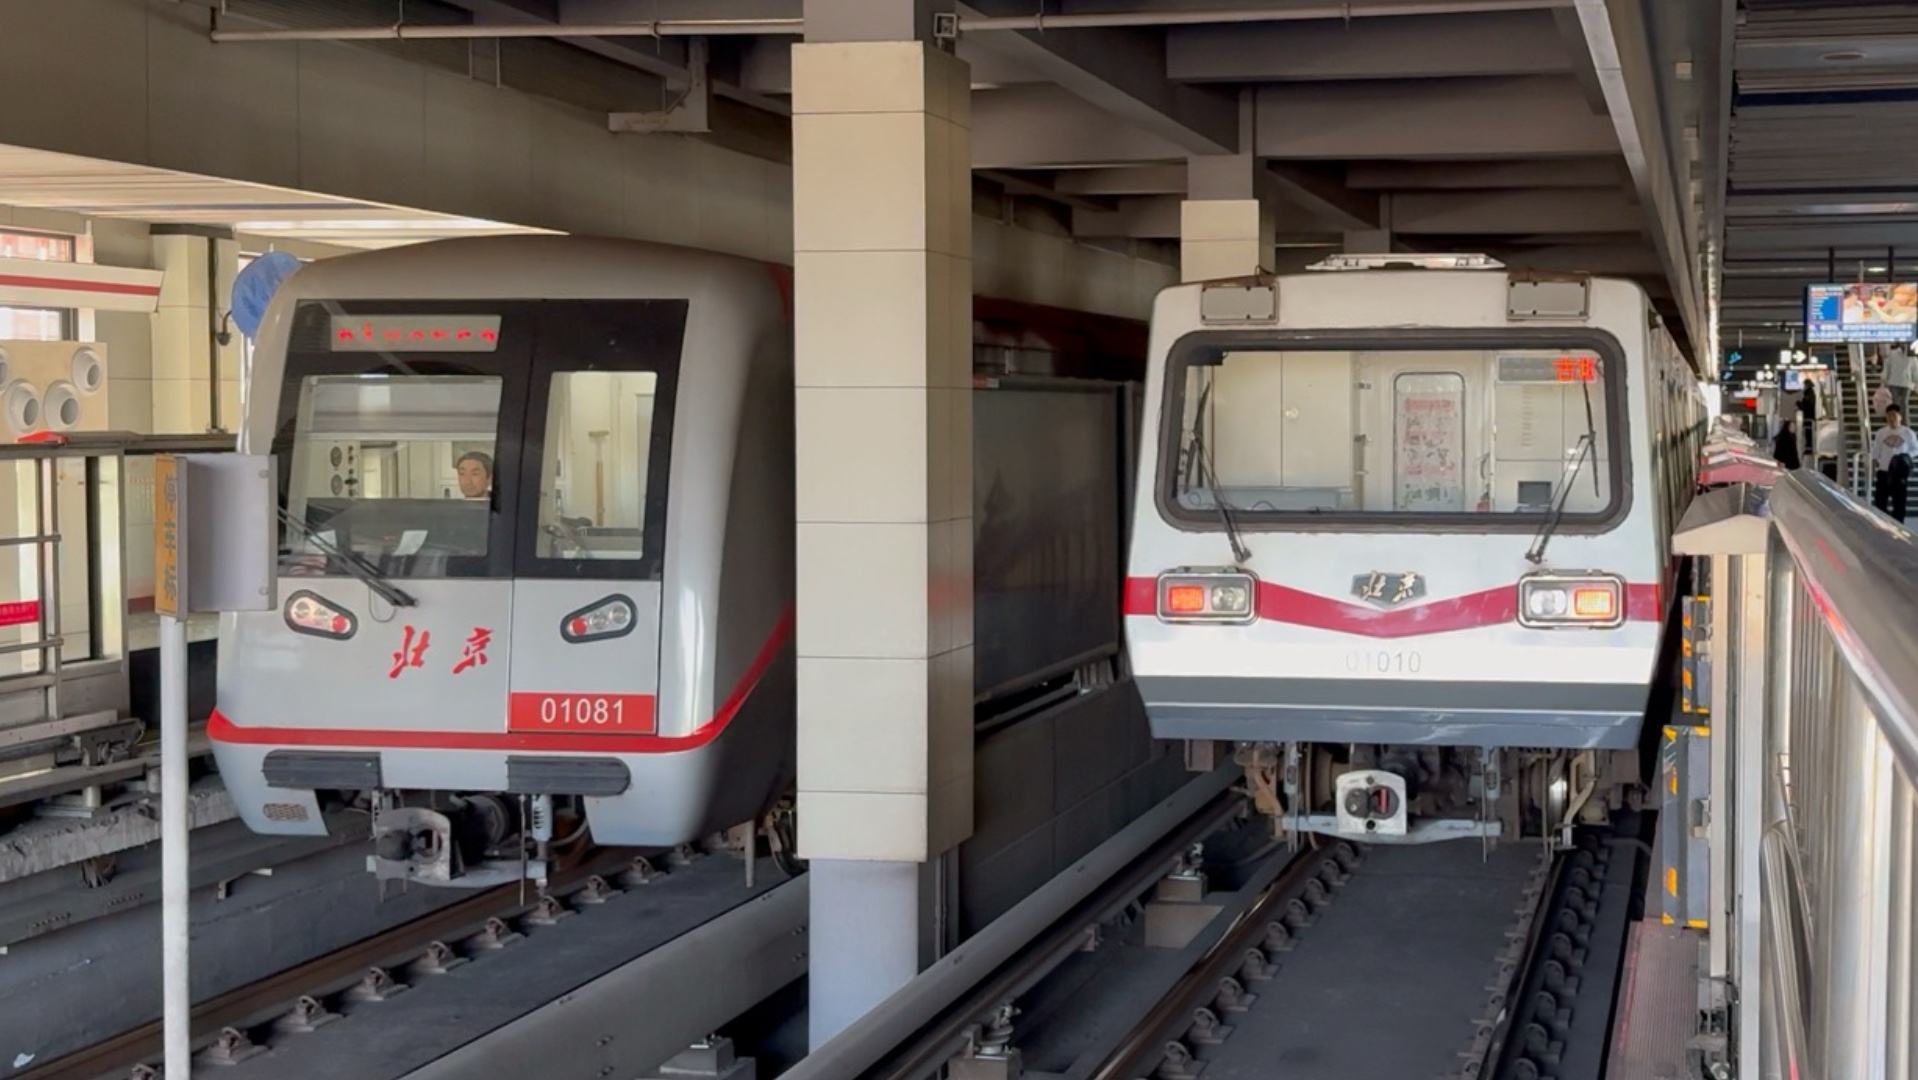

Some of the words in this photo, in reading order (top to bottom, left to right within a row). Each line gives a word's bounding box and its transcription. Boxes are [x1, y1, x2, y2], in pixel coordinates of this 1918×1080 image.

[1361, 570, 1417, 603] 北京
[389, 625, 493, 679] 北京
[540, 697, 624, 725] 01081
